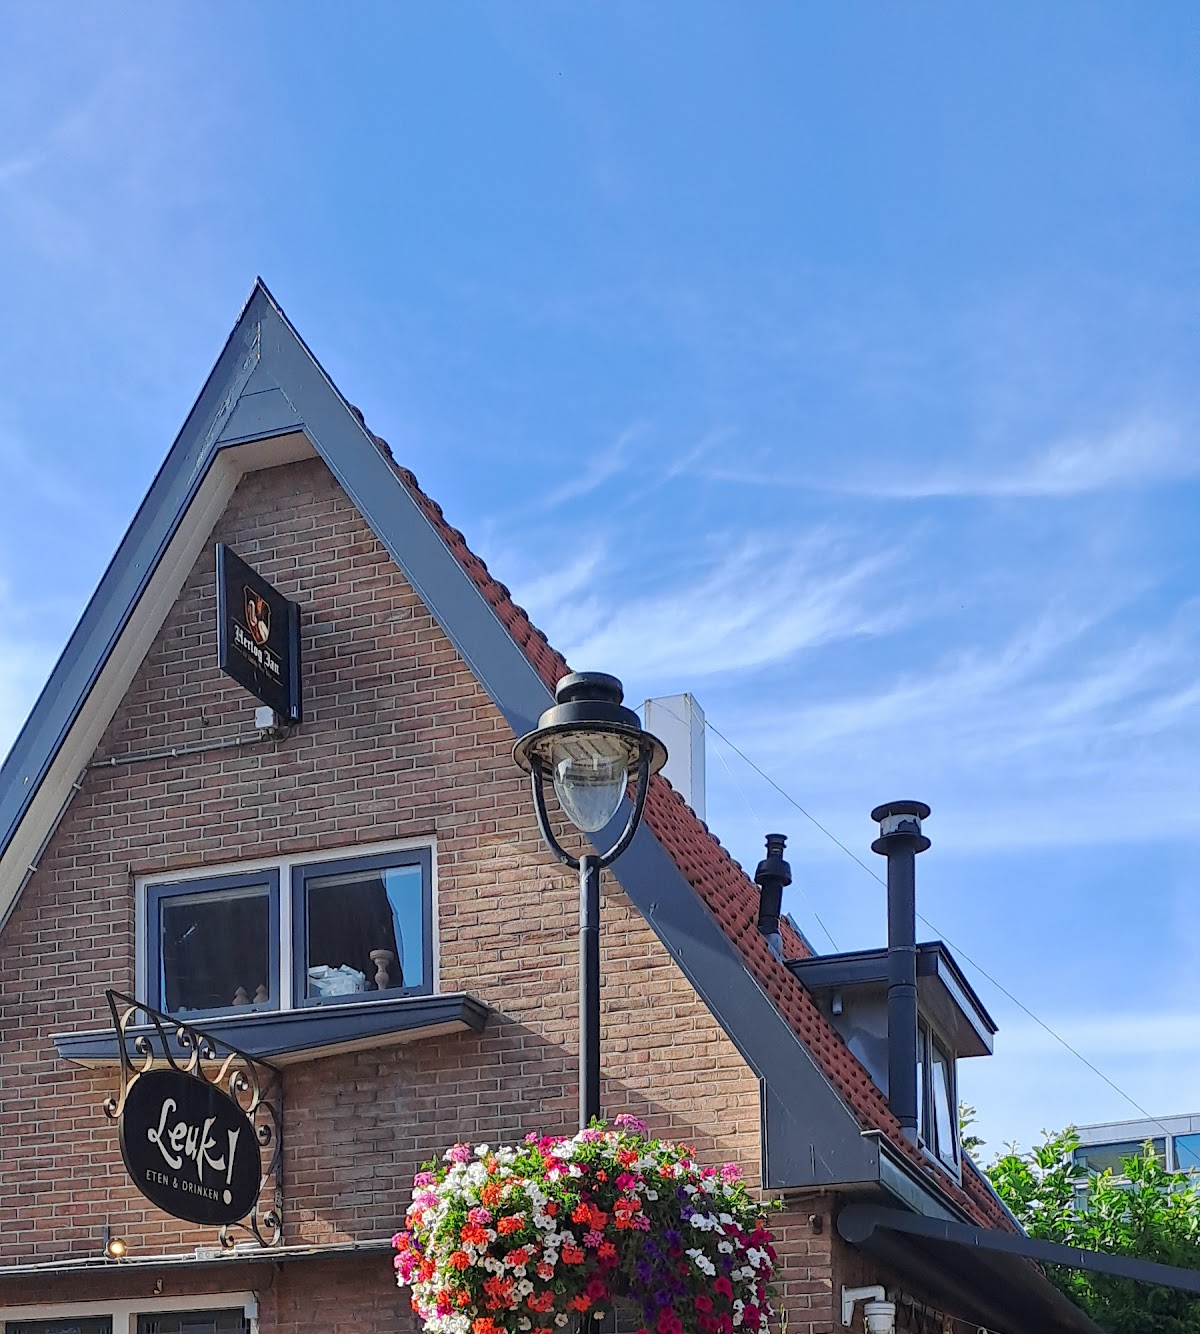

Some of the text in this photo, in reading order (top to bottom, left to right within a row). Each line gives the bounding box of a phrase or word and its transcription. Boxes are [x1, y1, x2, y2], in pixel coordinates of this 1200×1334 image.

[234, 624, 263, 664] Hertog
[263, 649, 280, 676] Jan
[147, 1098, 241, 1205] Leuk!
[146, 1169, 219, 1201] ETEN & DRINKEN
